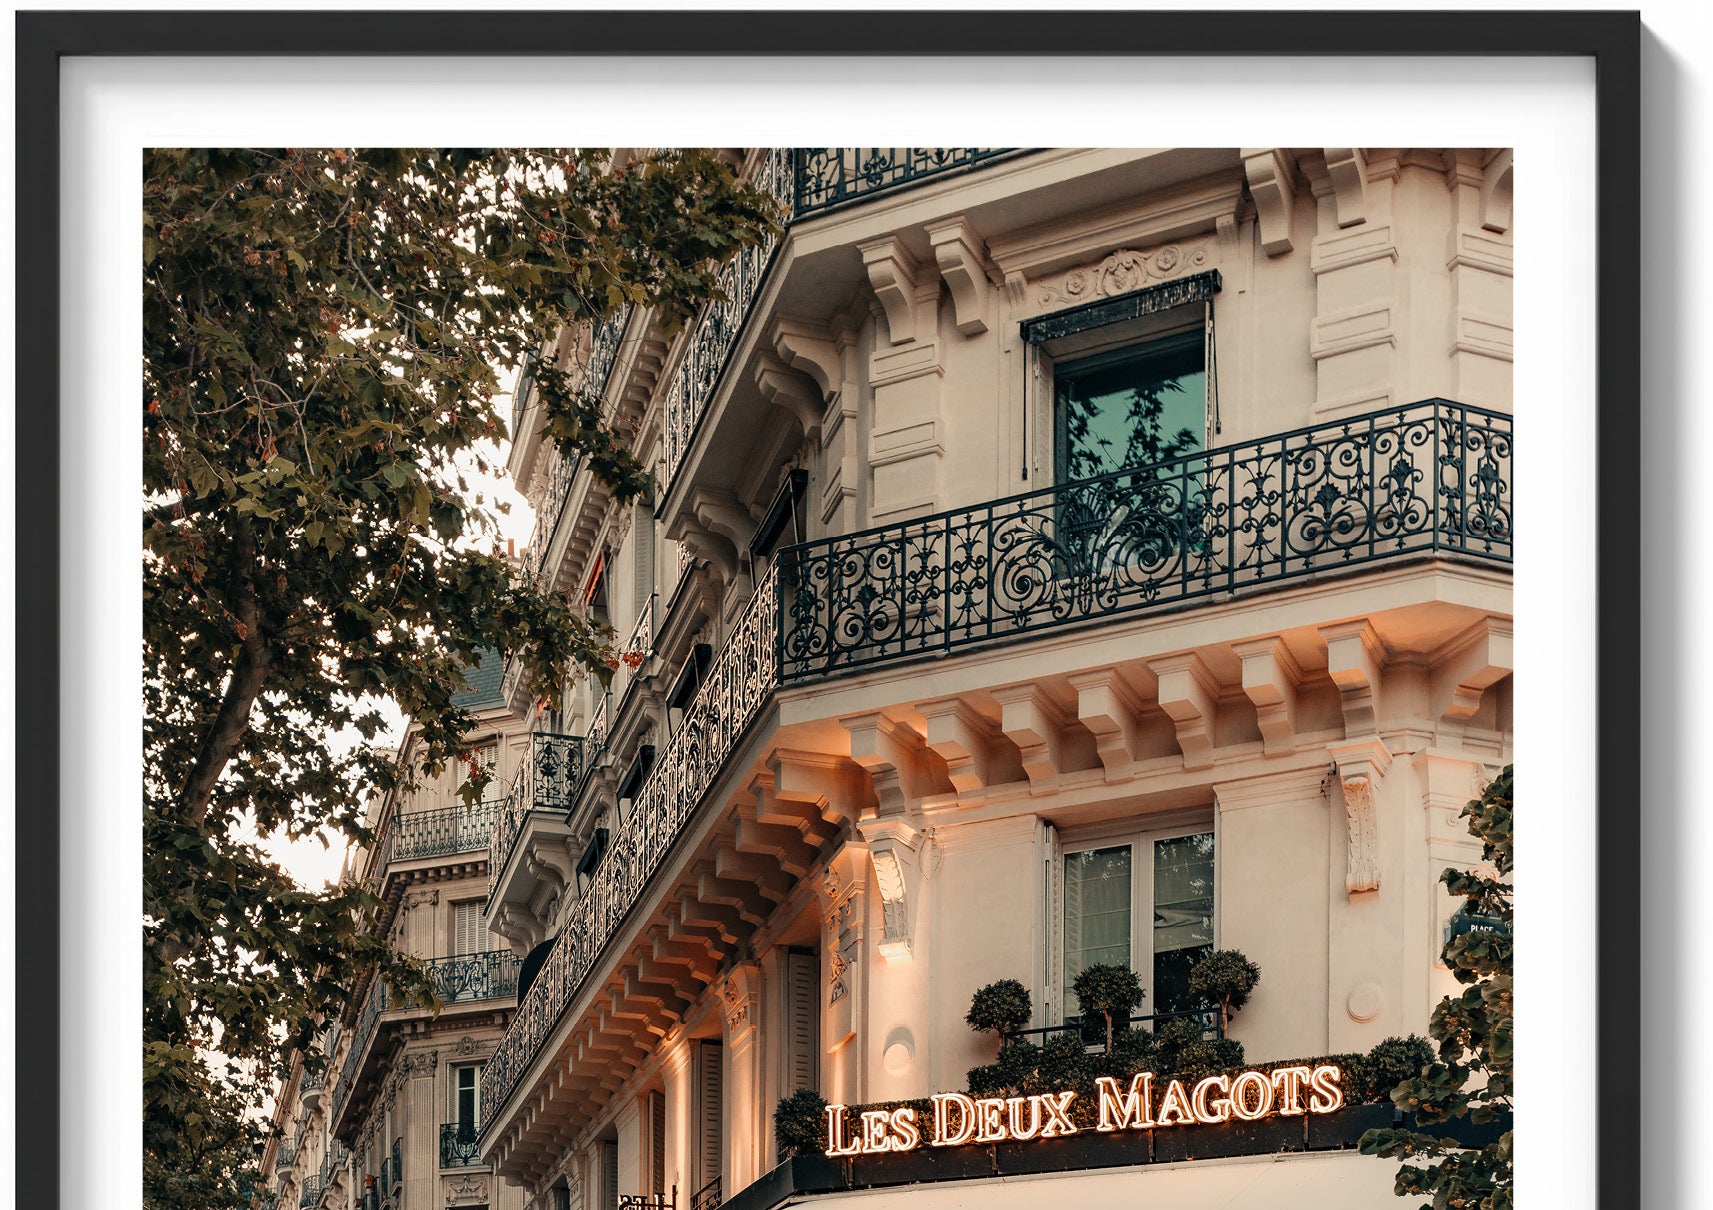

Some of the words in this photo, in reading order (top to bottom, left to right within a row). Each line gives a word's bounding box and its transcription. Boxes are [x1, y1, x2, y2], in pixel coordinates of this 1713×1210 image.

[824, 1104, 920, 1157] LES
[931, 1092, 1078, 1147] DEUX
[1095, 1065, 1344, 1132] MAGOTS
